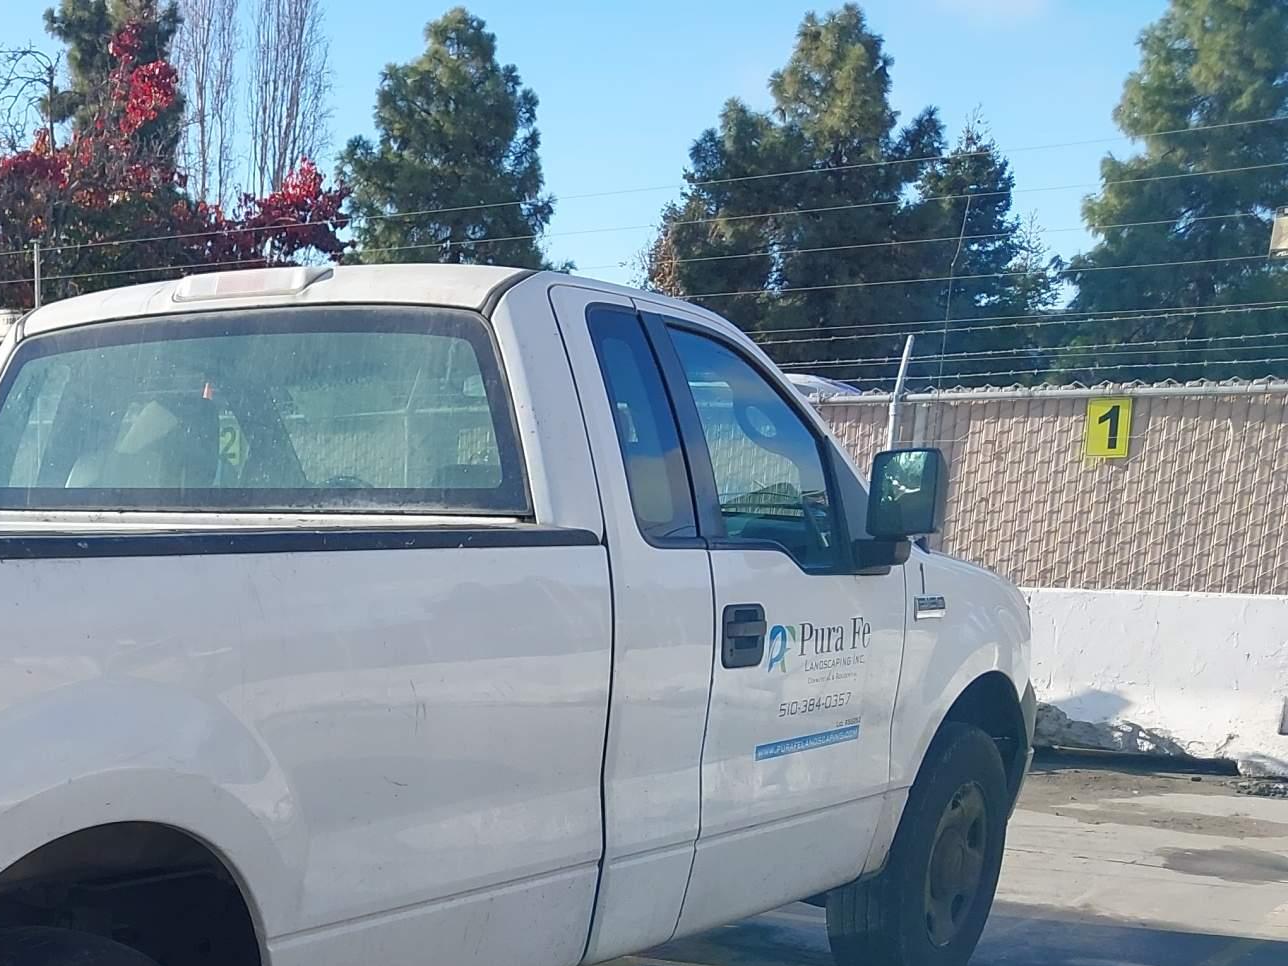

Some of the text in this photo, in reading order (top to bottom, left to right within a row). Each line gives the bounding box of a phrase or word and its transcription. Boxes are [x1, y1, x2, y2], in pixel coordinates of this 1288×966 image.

[221, 426, 236, 459] 2
[1098, 405, 1120, 449] 1
[798, 616, 871, 657] Pura Fe
